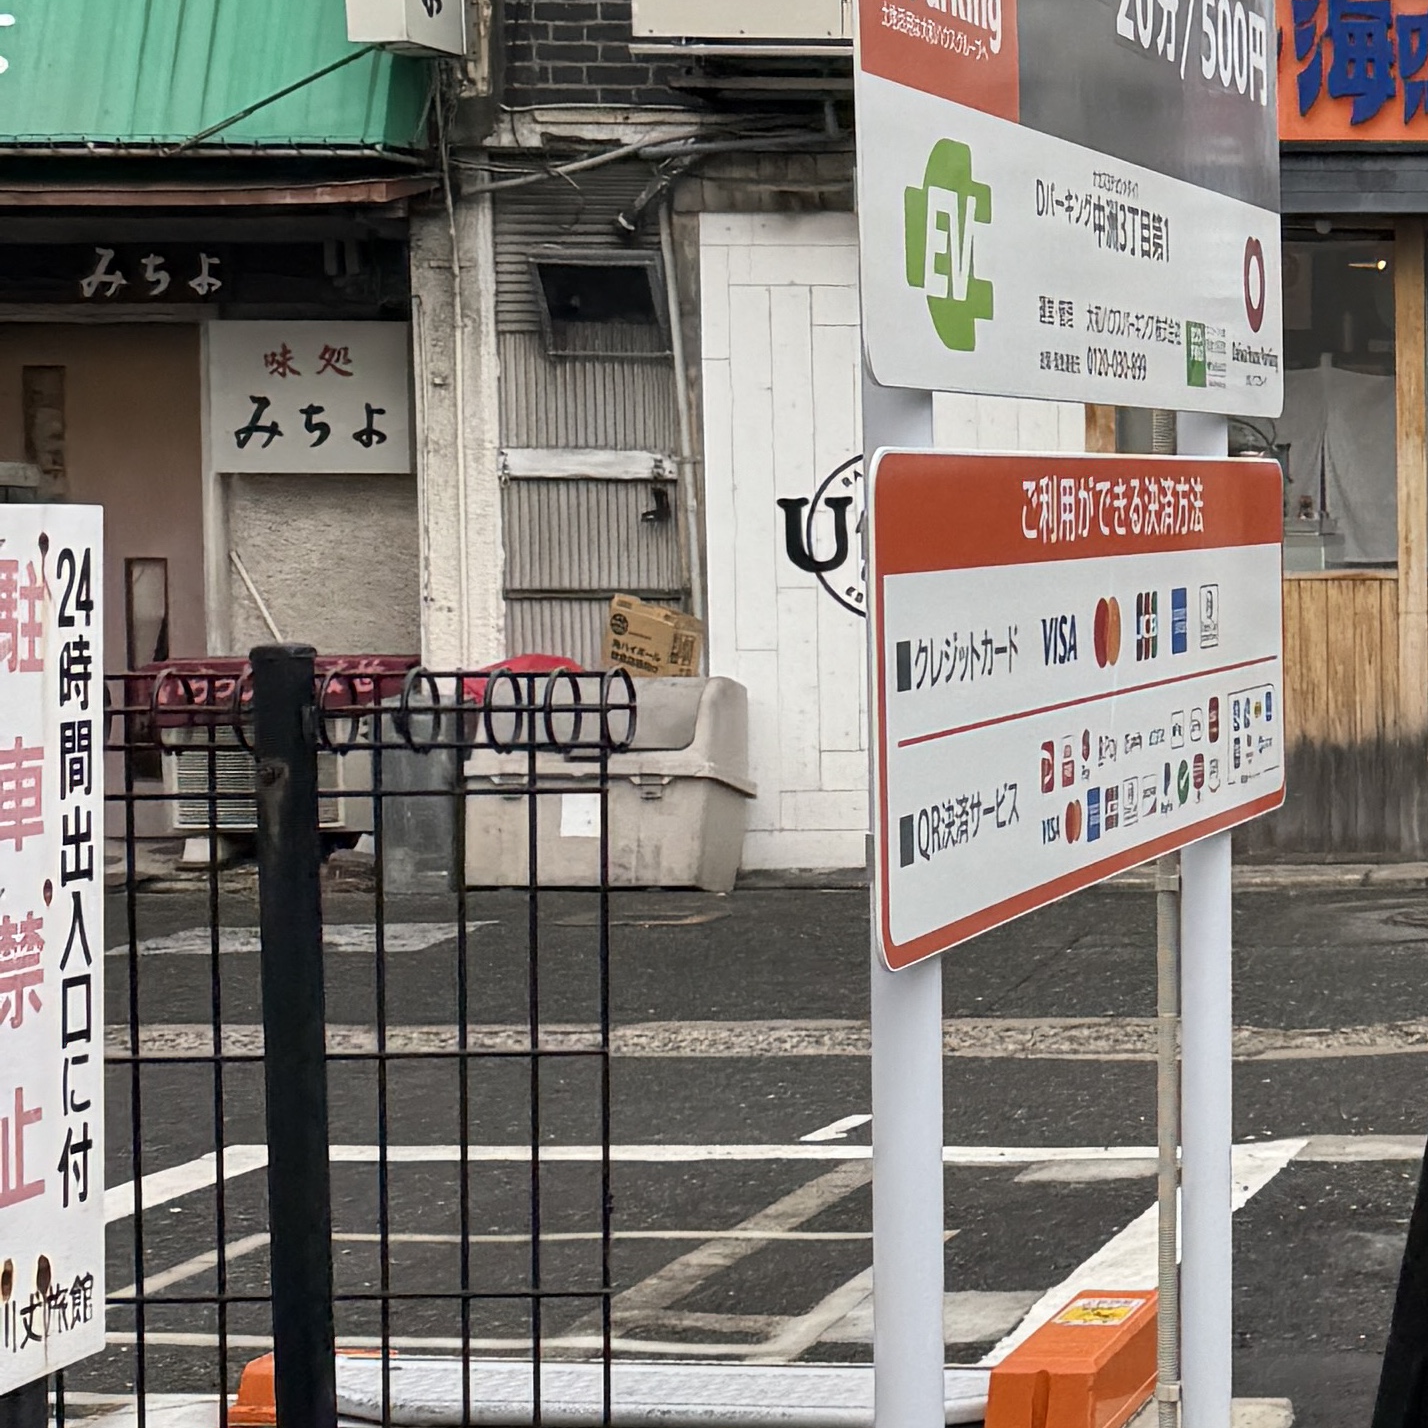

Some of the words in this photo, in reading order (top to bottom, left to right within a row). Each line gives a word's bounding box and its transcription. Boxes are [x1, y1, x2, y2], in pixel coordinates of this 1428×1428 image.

[80, 247, 222, 298] みちよ
[923, 185, 978, 302] EV
[263, 341, 355, 378] 味処
[234, 394, 388, 449] みちよ
[1021, 474, 1205, 545] ご利用ができる決済方法
[915, 624, 1020, 691] クレジットカード
[1041, 614, 1078, 666] VISA
[917, 781, 1020, 859] QR決済サービス
[56, 546, 95, 1210] 24時間出入口に付
